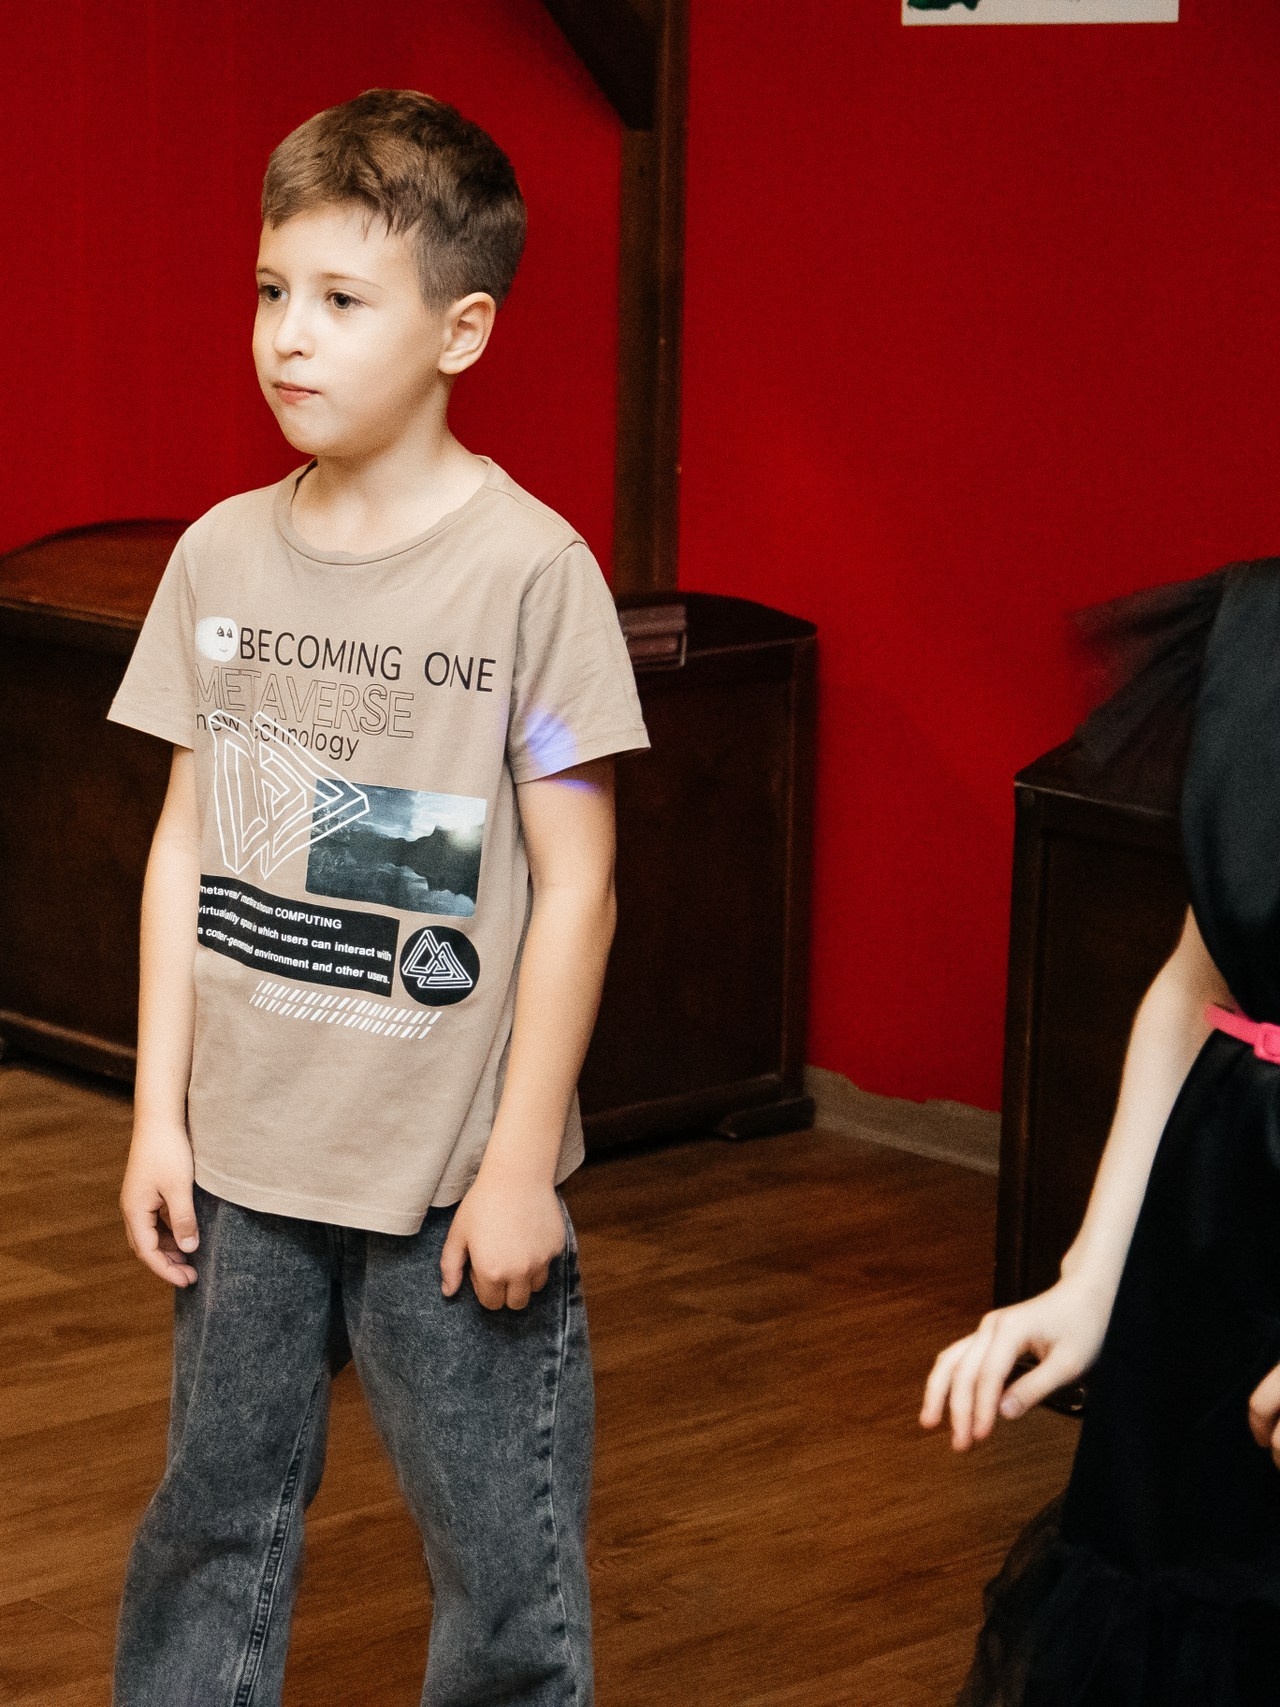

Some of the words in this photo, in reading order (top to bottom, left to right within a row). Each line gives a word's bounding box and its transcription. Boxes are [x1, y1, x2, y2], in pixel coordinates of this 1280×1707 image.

[239, 626, 403, 681] BECOMING
[423, 651, 497, 693] ONE
[195, 663, 415, 739] METAVERSE
[257, 925, 279, 940] which
[281, 933, 308, 946] users
[311, 939, 331, 951] can
[334, 941, 376, 958] interact
[376, 949, 392, 962] with
[275, 907, 342, 929] COMPUTING
[197, 926, 204, 935] a
[254, 948, 310, 969] environment
[312, 963, 333, 974] and
[335, 965, 365, 979] other
[367, 971, 391, 985] users.
